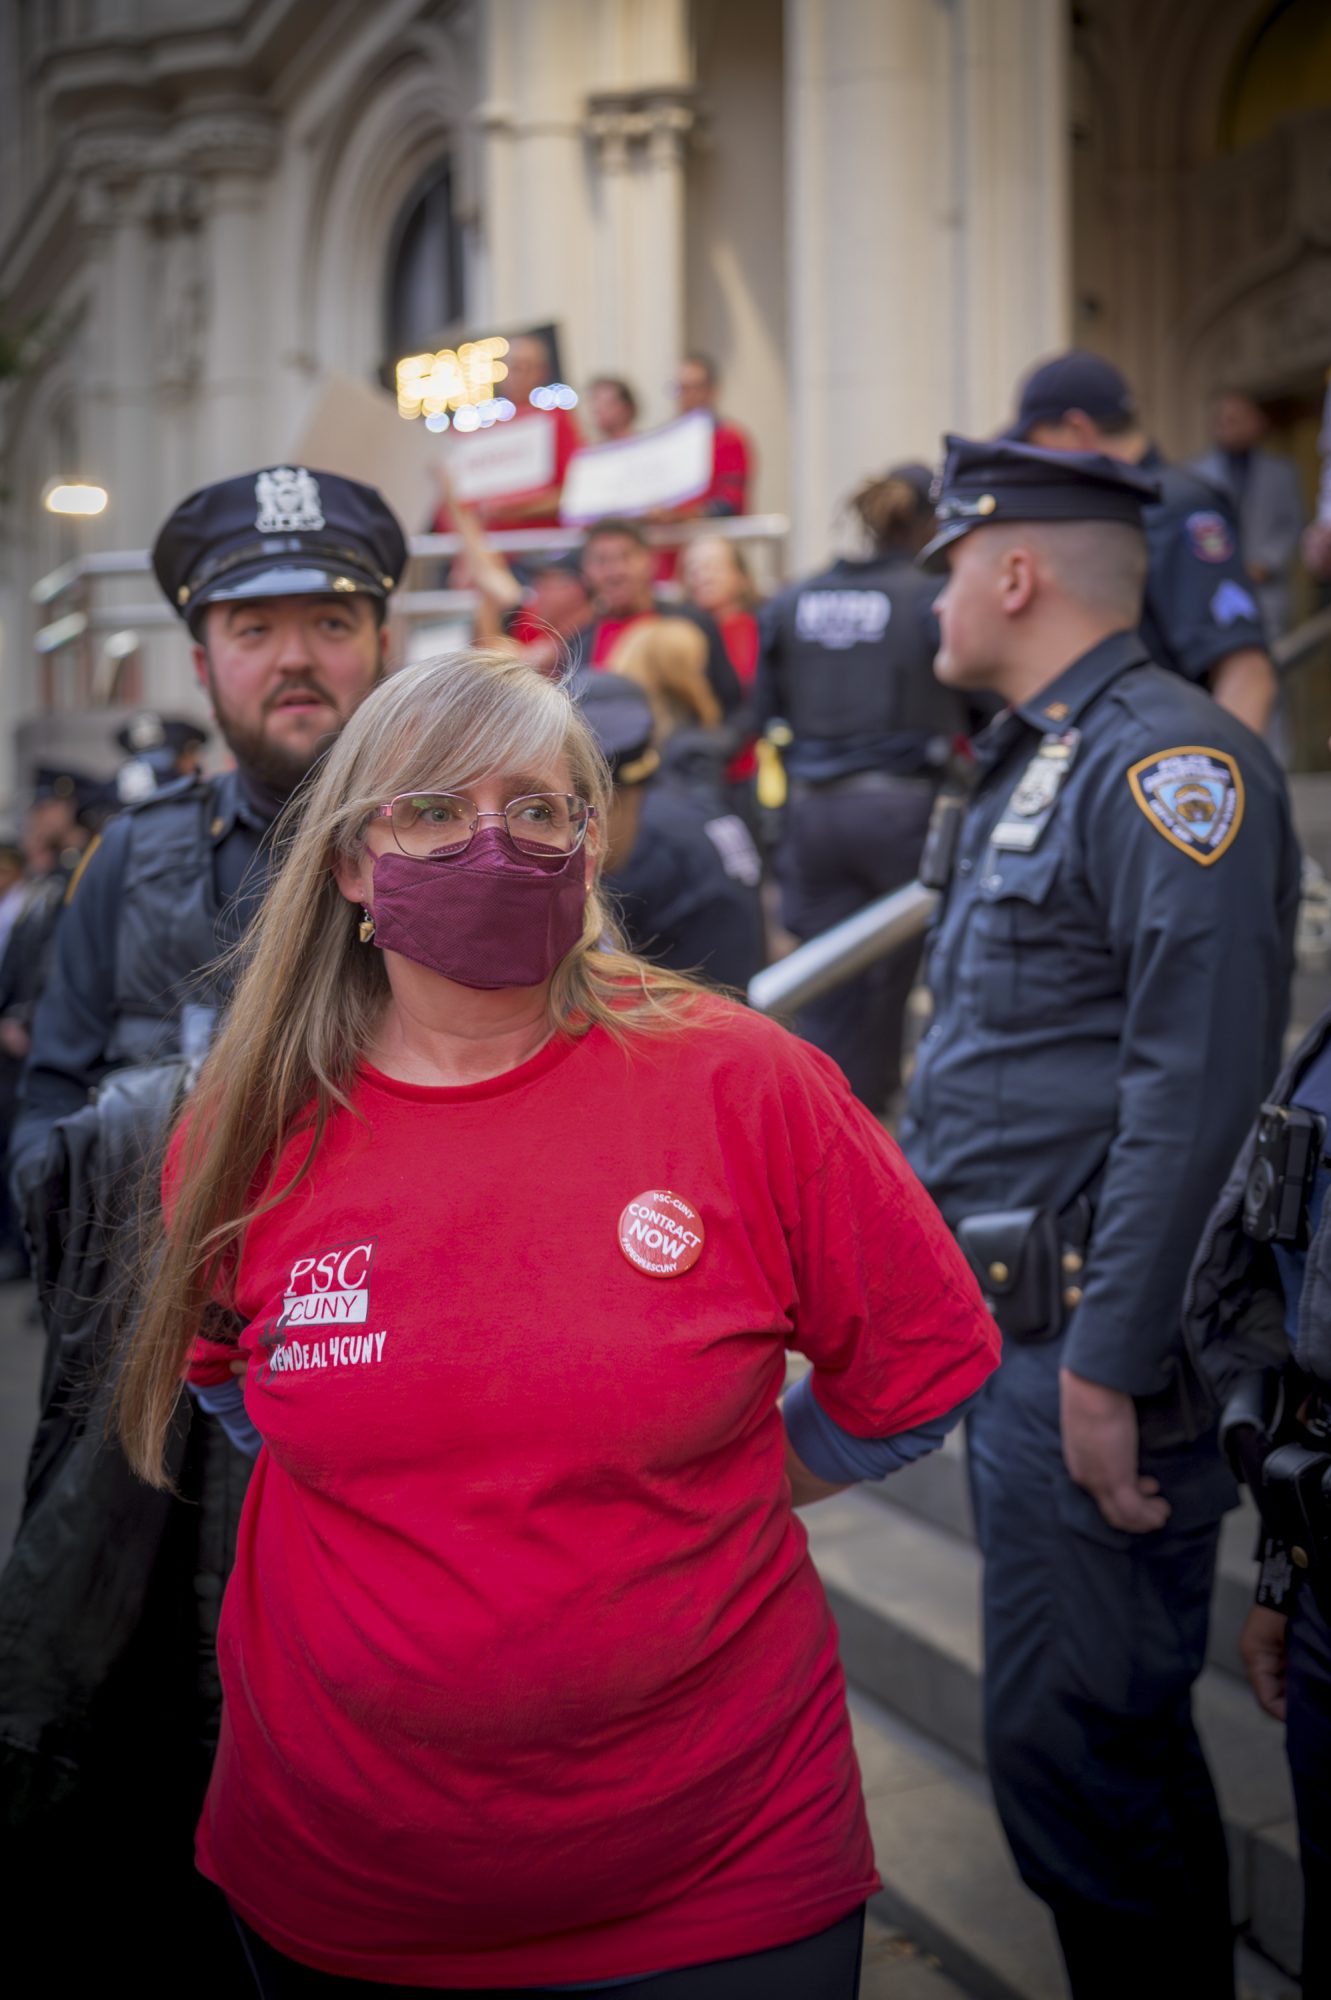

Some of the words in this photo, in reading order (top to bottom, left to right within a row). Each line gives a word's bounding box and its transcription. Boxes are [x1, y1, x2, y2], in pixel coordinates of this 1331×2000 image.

[628, 1203, 702, 1248] CONTRACT
[653, 1193, 695, 1219] PSC-CUNY
[628, 1218, 687, 1260] NOW
[284, 1243, 372, 1297] PSC
[289, 1295, 358, 1322] CUNY
